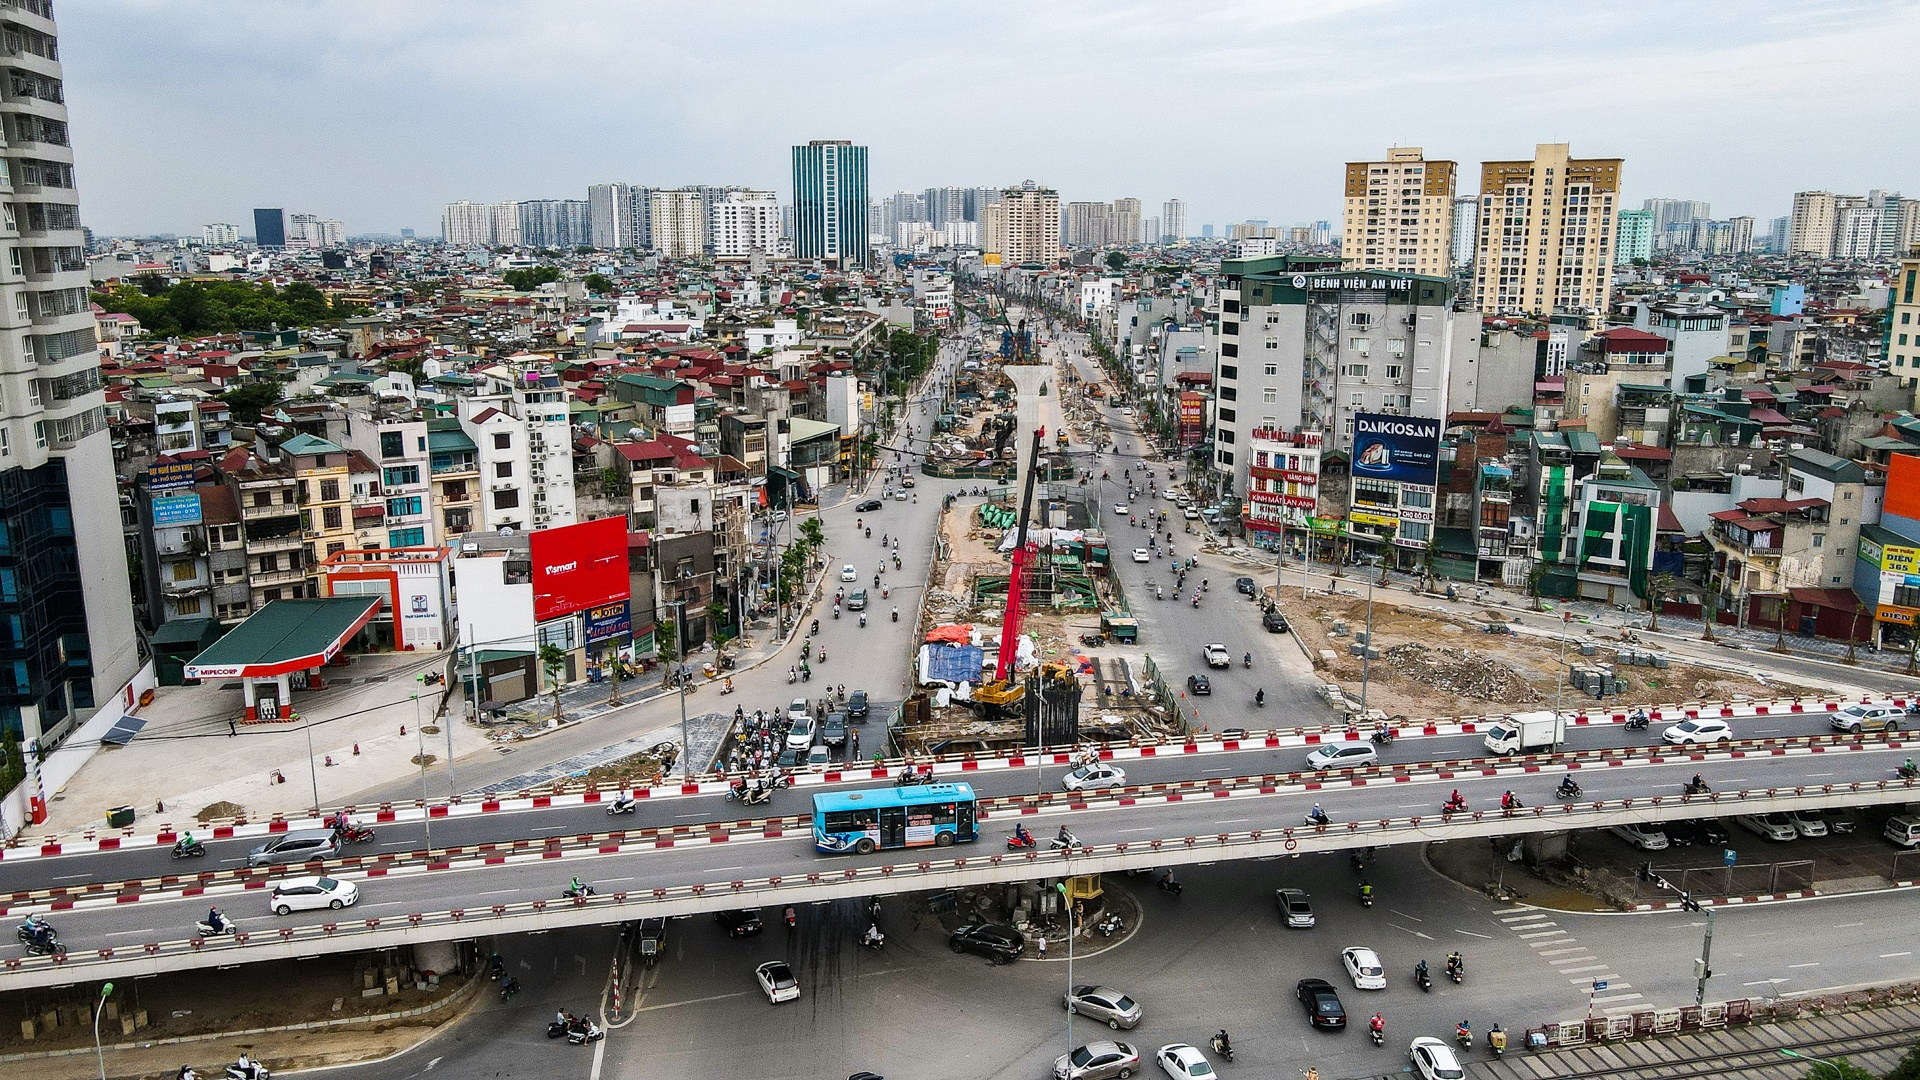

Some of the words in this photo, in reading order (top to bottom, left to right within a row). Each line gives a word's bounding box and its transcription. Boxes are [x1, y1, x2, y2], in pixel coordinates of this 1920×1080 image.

[1343, 276, 1367, 291] VIỆN
[1371, 279, 1386, 289] AN
[1390, 277, 1413, 291] VIỆT
[1252, 426, 1268, 439] KÍNH
[1306, 434, 1323, 446] ANH
[1359, 420, 1435, 438] DAIKIOSAN
[1252, 493, 1267, 502] KÍNH
[1298, 500, 1313, 508] ANH
[1889, 563, 1908, 571] 365
